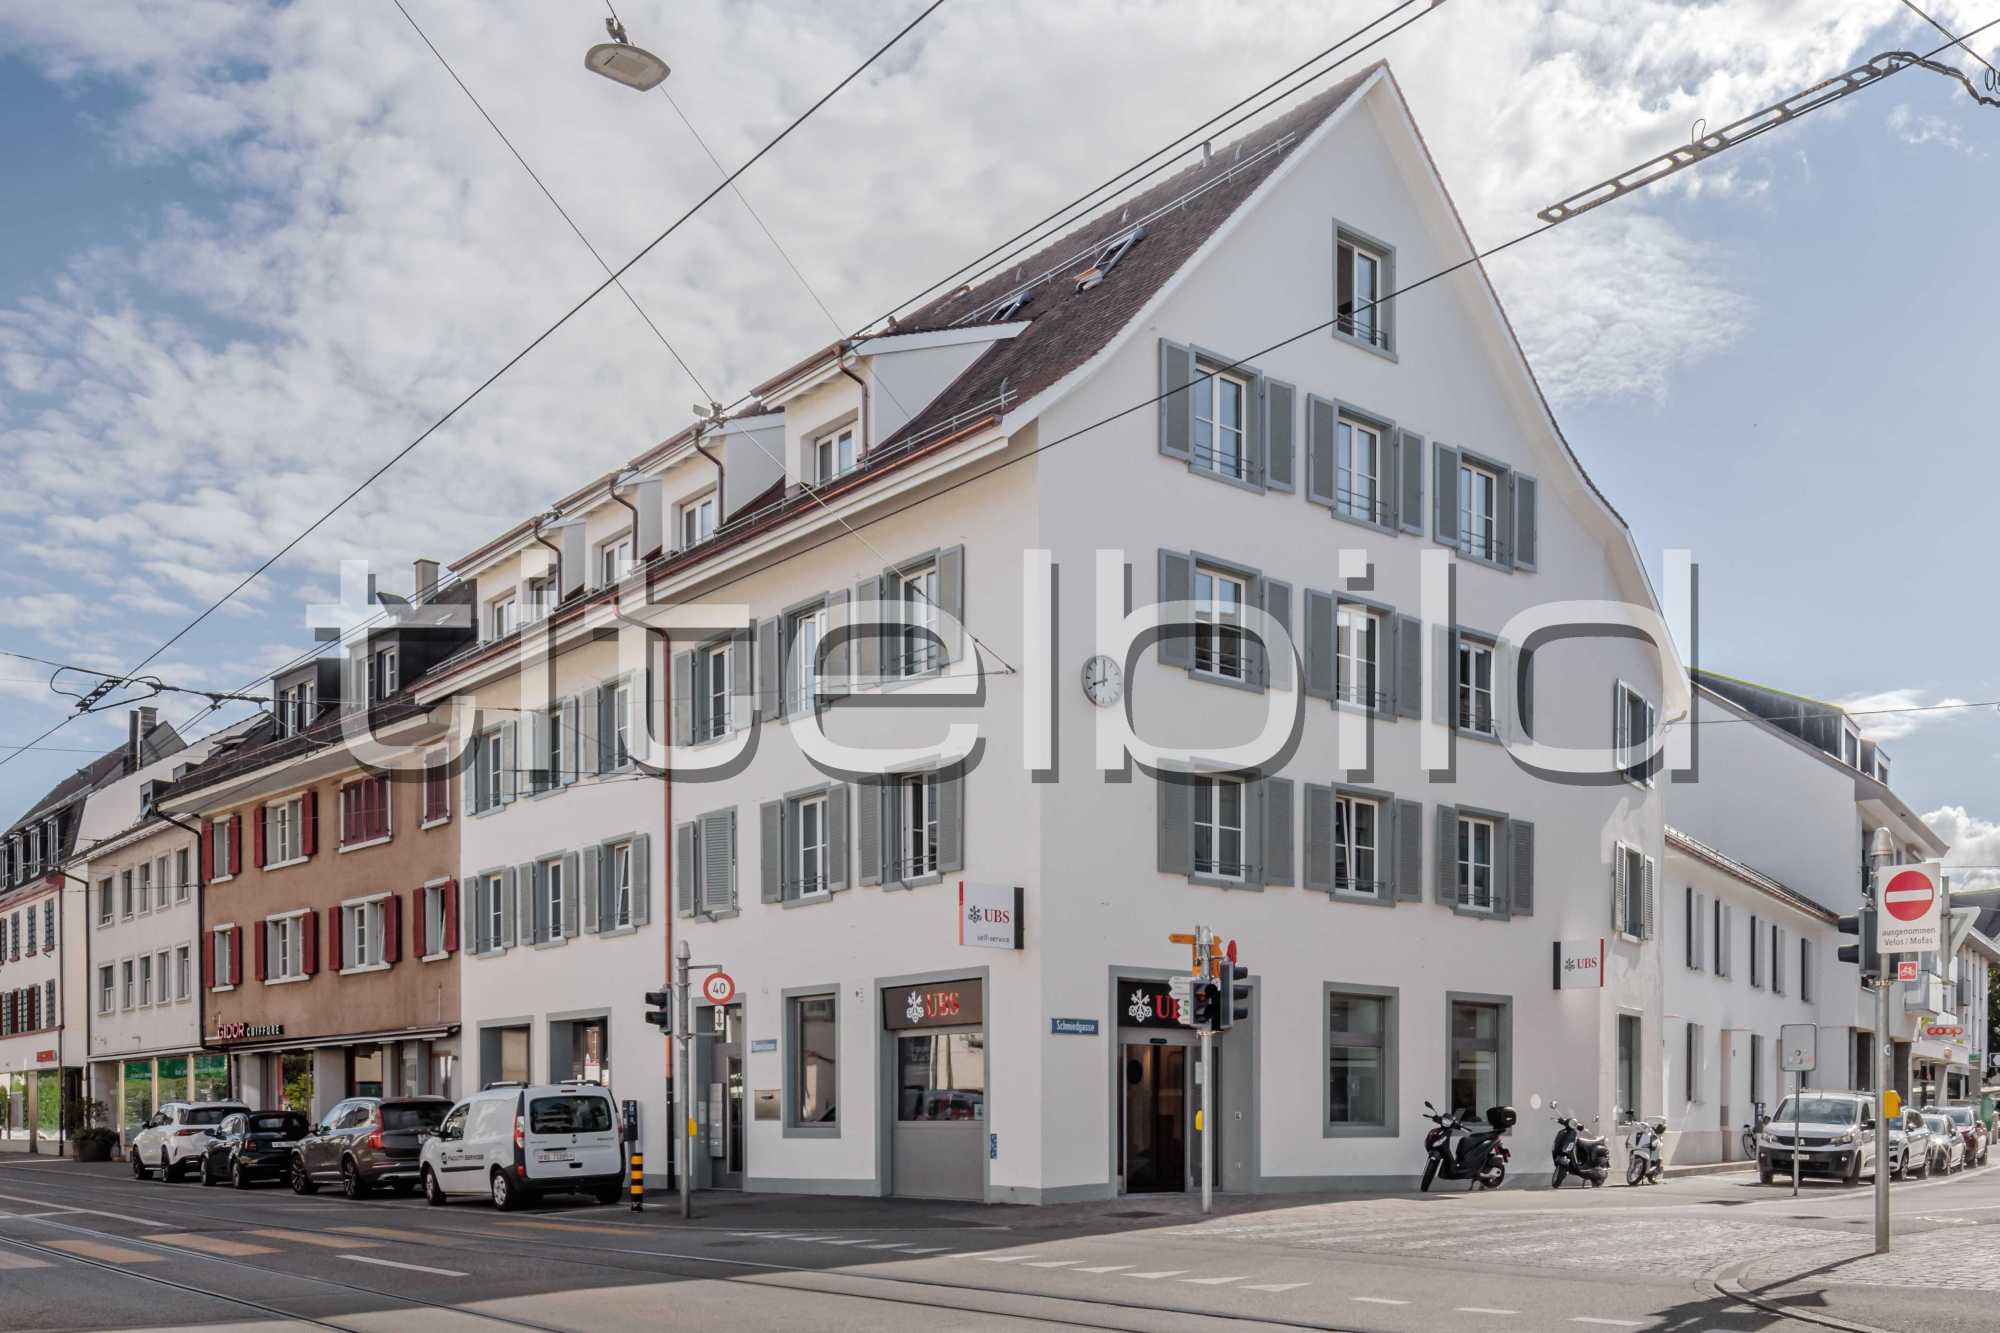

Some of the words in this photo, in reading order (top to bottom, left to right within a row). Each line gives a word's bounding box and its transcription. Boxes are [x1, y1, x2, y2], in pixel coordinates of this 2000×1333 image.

[984, 908, 1010, 924] UBS
[1881, 927, 1936, 938] ausgenommen
[1884, 937, 1904, 946] Velos
[1576, 957, 1598, 969] UBS
[712, 982, 726, 994] 40
[926, 991, 960, 1017] UBS
[217, 1023, 245, 1040] GIDOR
[1056, 1019, 1095, 1033] Schmiedgasse
[1926, 1026, 1964, 1037] coop
